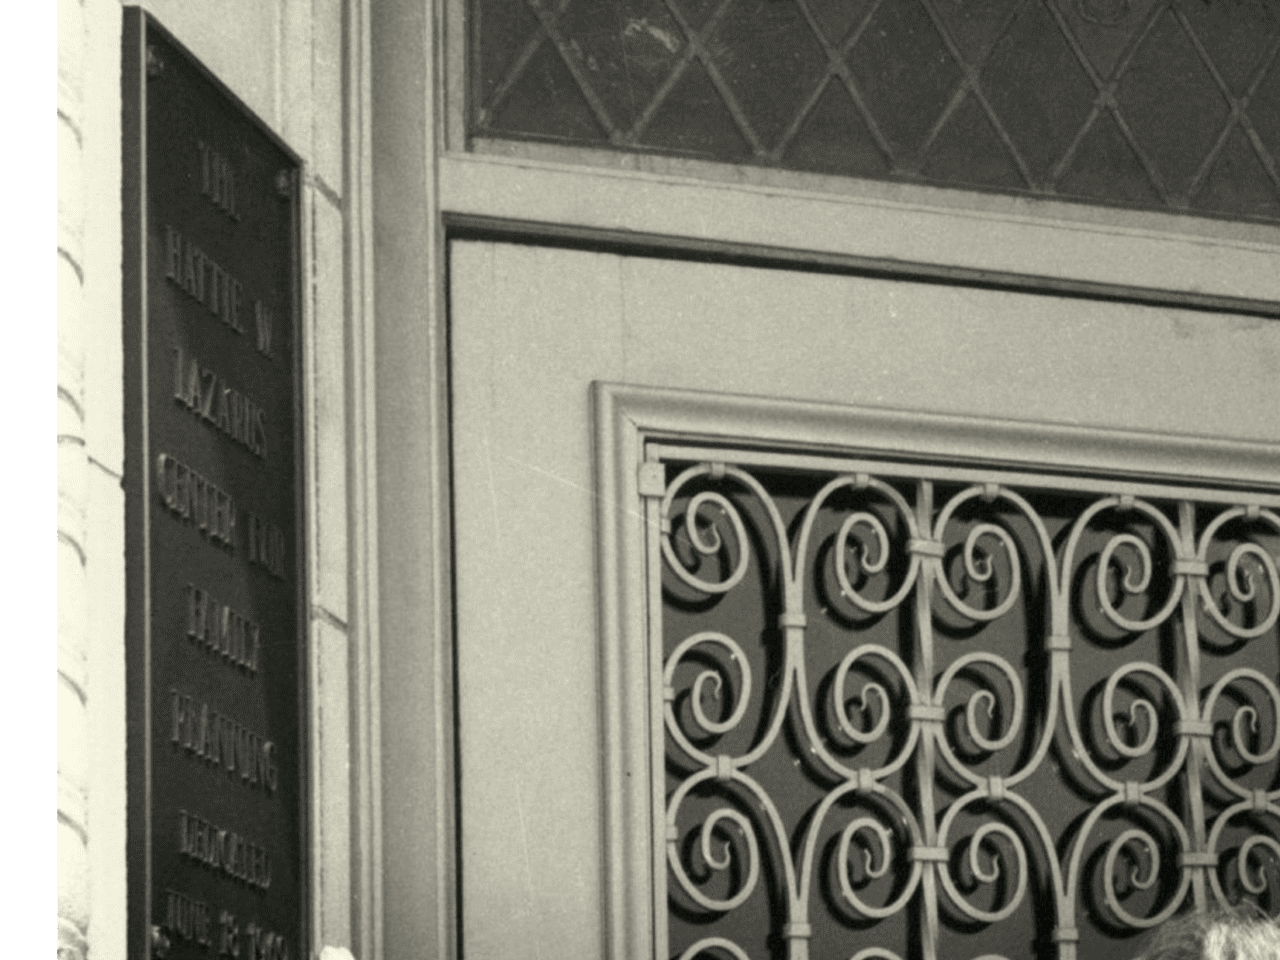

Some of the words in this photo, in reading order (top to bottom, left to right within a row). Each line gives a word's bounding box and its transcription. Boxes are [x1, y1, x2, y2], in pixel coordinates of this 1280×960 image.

[165, 224, 244, 334] HATTIE
[174, 345, 267, 457] LAZARUS
[156, 453, 236, 548] CENTER
[185, 582, 260, 671] FAMILY
[169, 688, 277, 791] PLANNING
